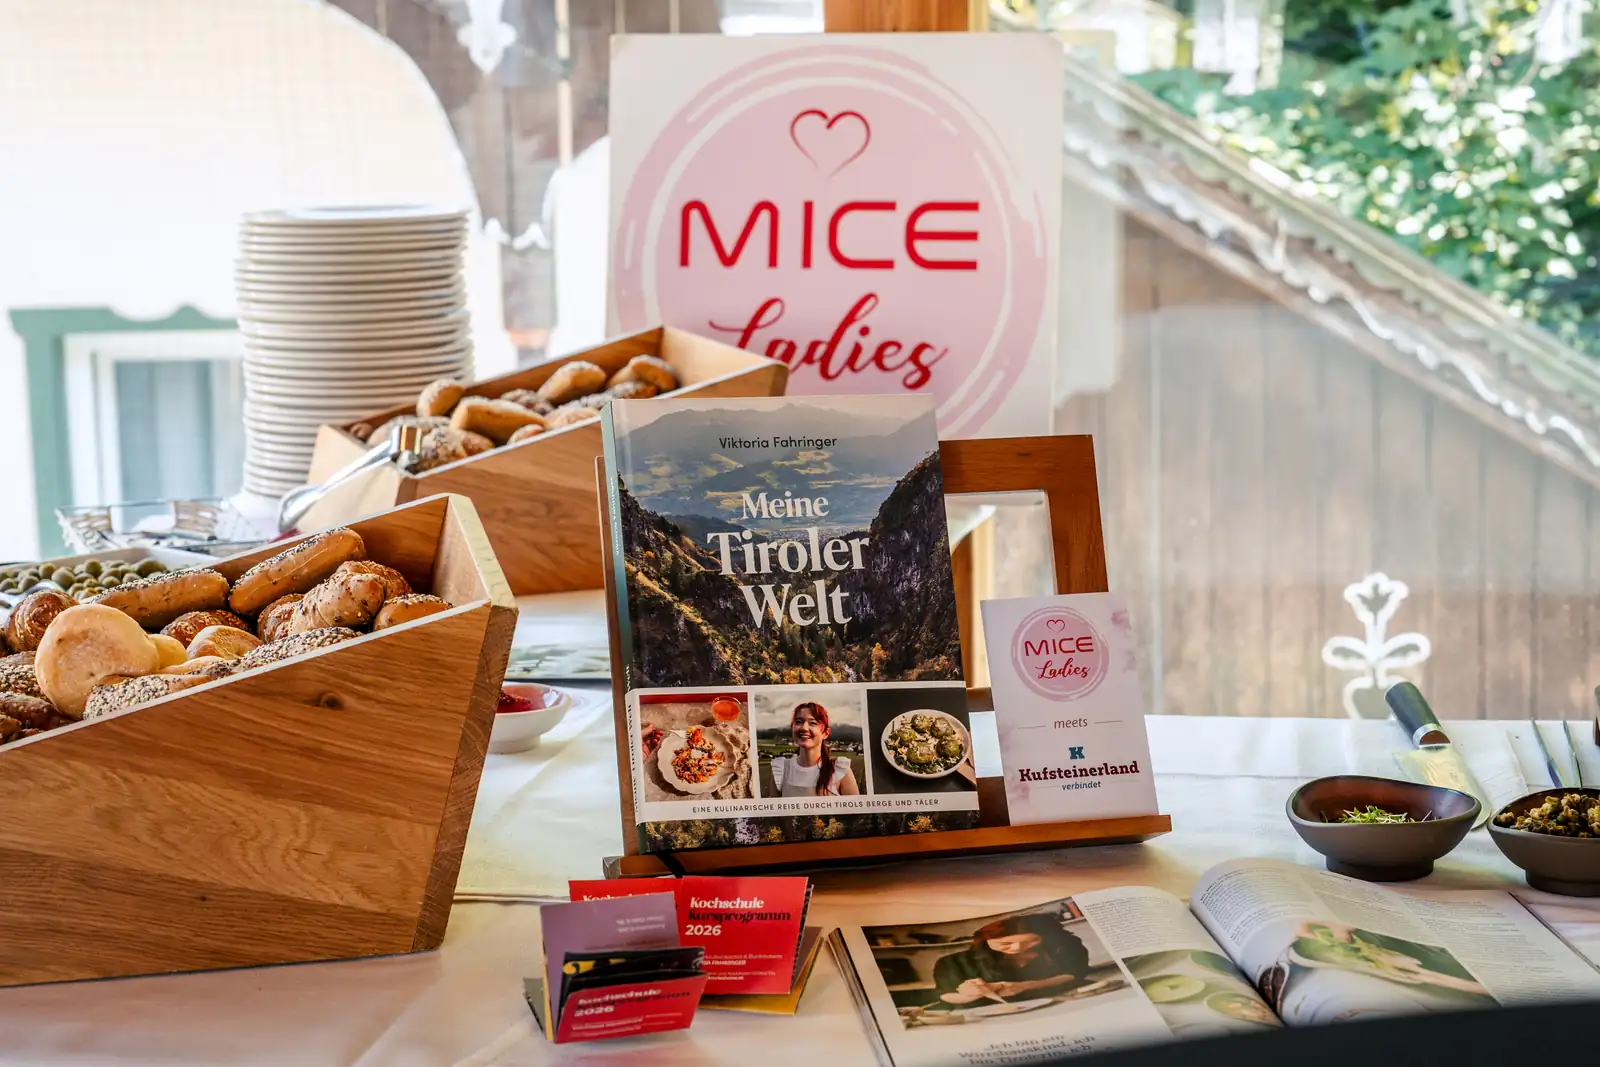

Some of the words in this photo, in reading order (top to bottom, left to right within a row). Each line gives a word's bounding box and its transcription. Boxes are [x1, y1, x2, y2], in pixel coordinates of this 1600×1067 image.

[679, 199, 980, 270] MICE
[708, 292, 949, 390] Ladies
[718, 437, 770, 450] Viktoria
[773, 436, 838, 451] Fahringer
[740, 490, 830, 521] Meine
[707, 526, 870, 576] Tiroler
[738, 579, 852, 629] Welt
[1023, 636, 1094, 657] MICE
[1035, 657, 1091, 680] Ladies
[1053, 717, 1089, 730] meets
[1018, 761, 1140, 782] Kufsteinerland
[1061, 780, 1102, 791] verbindet
[692, 806, 712, 814] EINE
[714, 804, 775, 813] KULINARISCHE
[777, 803, 801, 811] REISE
[803, 802, 832, 810] DURCH
[834, 801, 863, 809] TIROLS
[866, 800, 893, 808] BERGE
[895, 799, 912, 807] UND
[914, 798, 940, 806] TÄLER
[690, 896, 765, 909] Kochschule
[687, 909, 791, 924] Kursprogramm
[685, 924, 722, 936] 2026
[574, 1005, 615, 1018] 2026
